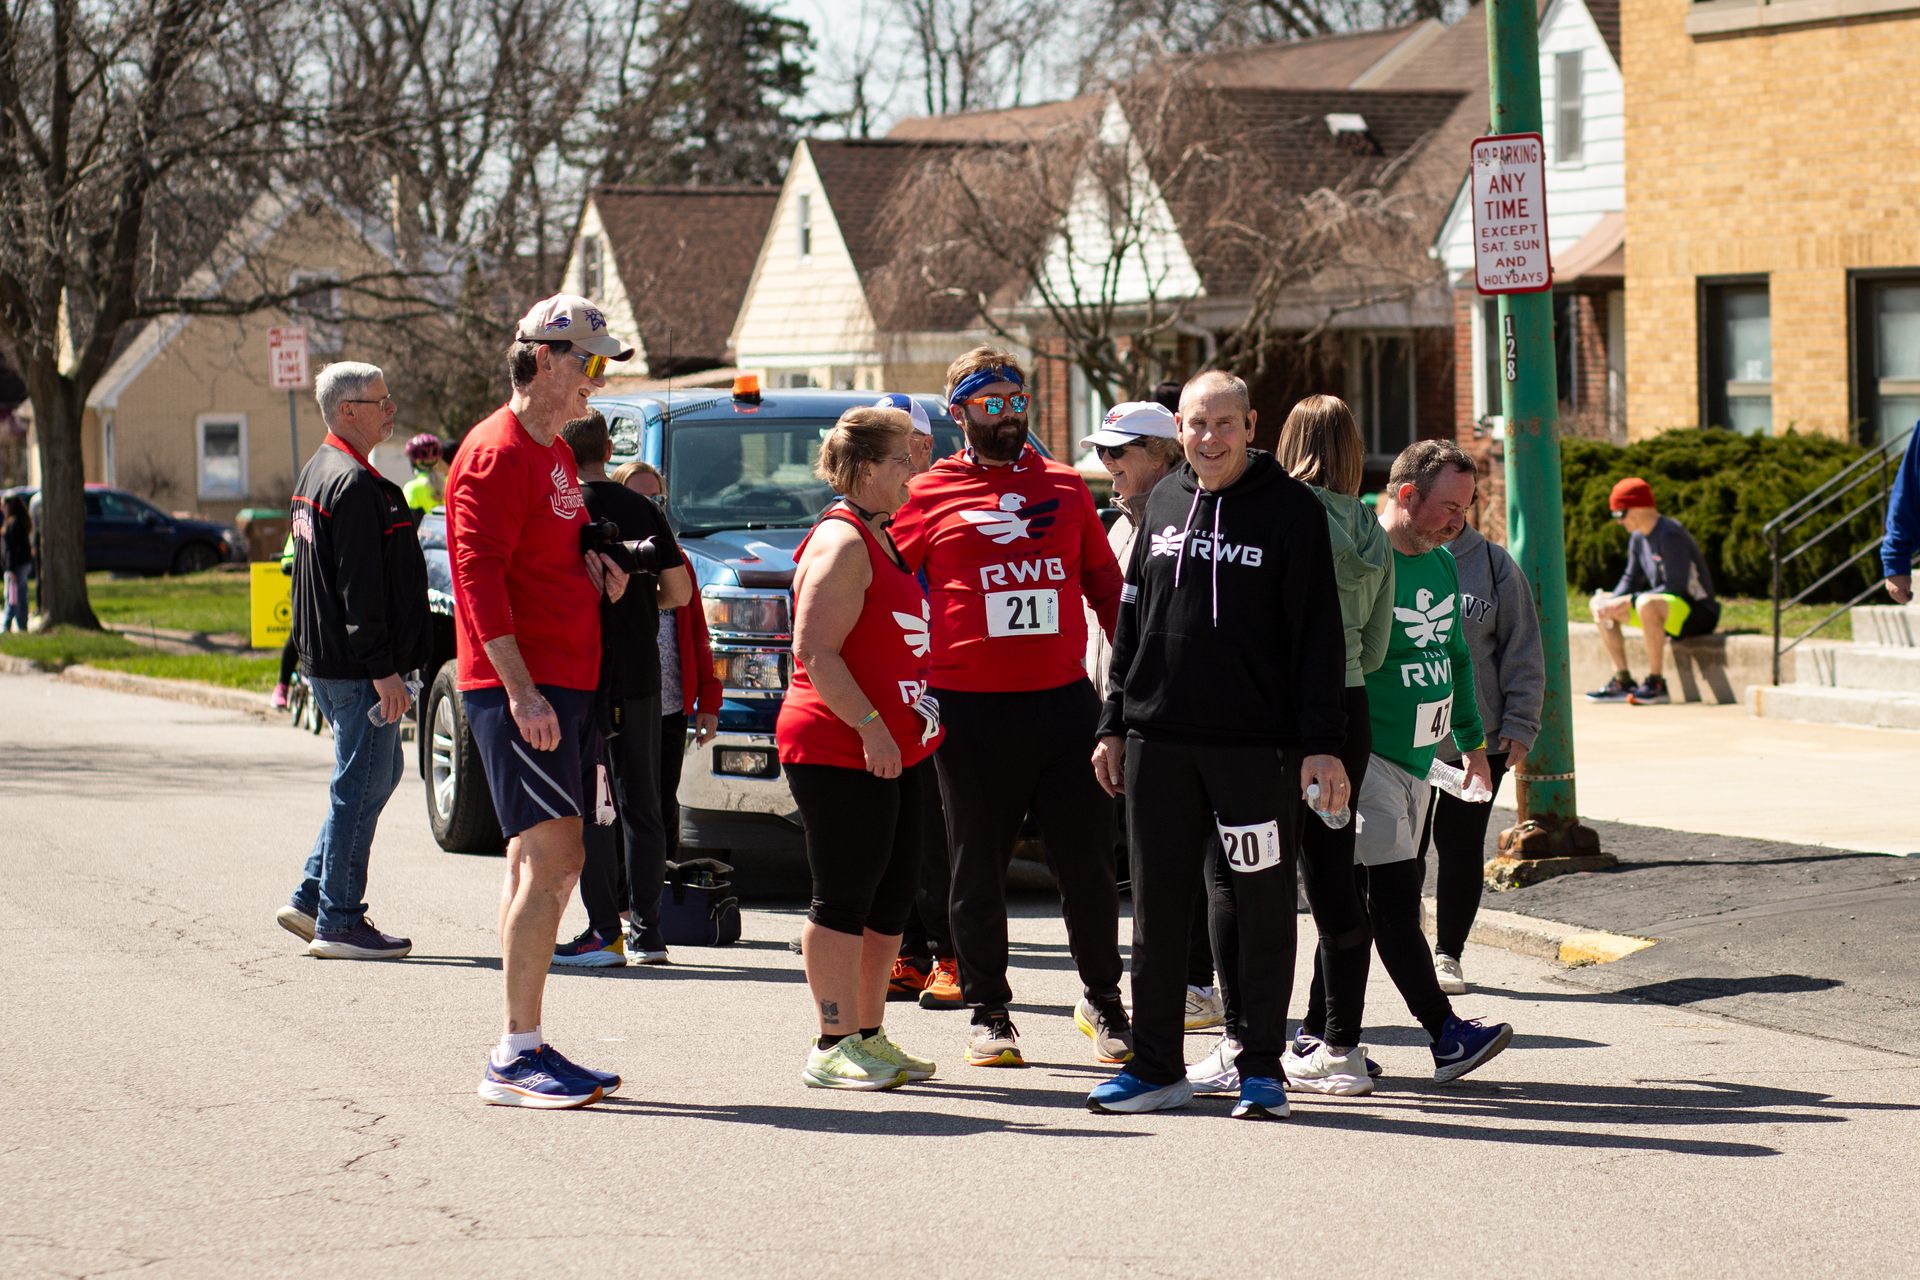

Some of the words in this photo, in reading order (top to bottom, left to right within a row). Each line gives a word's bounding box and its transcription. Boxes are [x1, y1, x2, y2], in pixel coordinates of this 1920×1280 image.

[1493, 144, 1537, 165] PARKING
[1489, 173, 1526, 194] ANY
[1484, 199, 1529, 220] TIME
[1482, 224, 1538, 238] EXCEPT
[1514, 240, 1540, 251] SUN
[1495, 256, 1527, 268] AND
[1484, 272, 1544, 286] HOLYDAYS
[278, 350, 300, 361] ANY
[1505, 316, 1517, 381] 128
[278, 362, 302, 374] TIME
[1194, 529, 1225, 540] TEAM
[1005, 550, 1042, 560] TEAM
[1190, 538, 1263, 567] RWB
[980, 558, 1066, 590] RWB
[1006, 595, 1041, 630] 21
[1461, 593, 1492, 624] VY
[1431, 701, 1450, 738] 47
[1223, 832, 1260, 867] 20
[576, 941, 602, 954] HOKA
